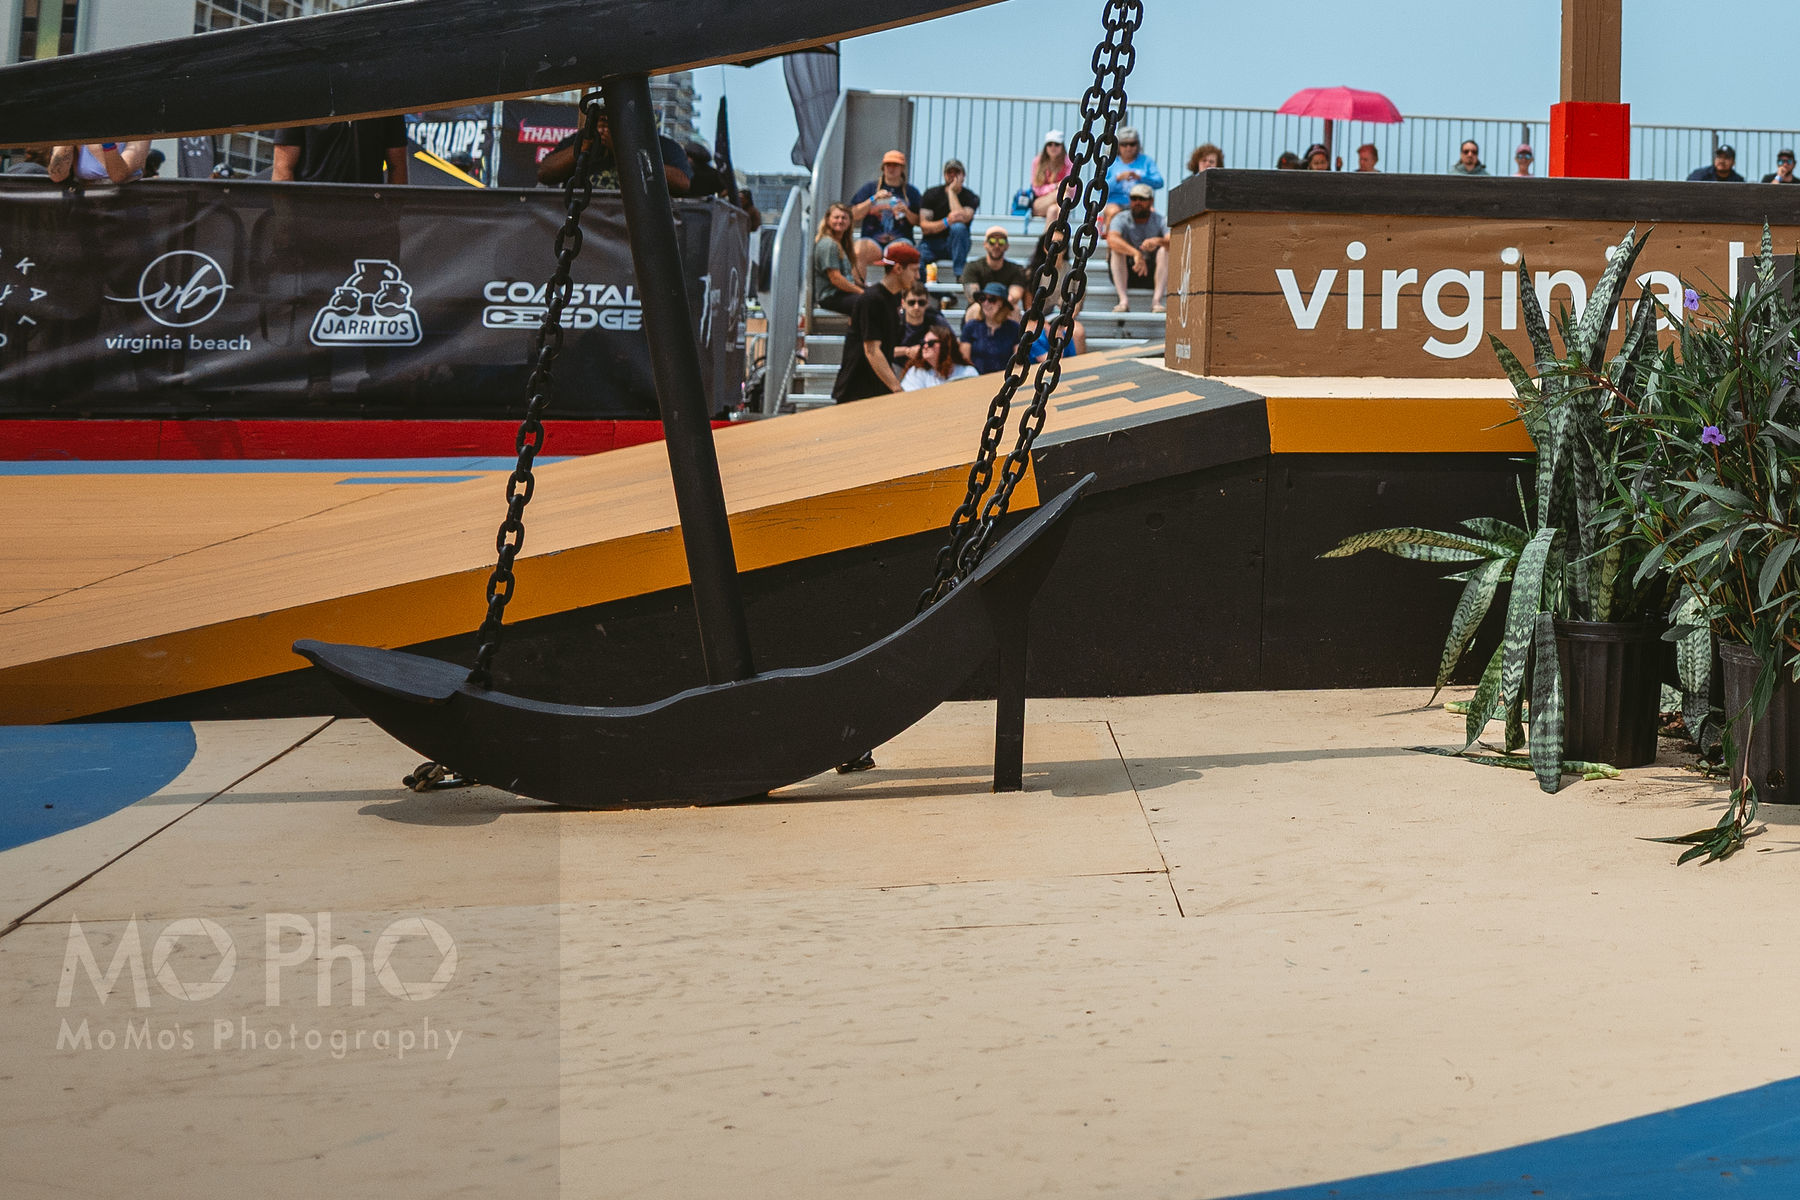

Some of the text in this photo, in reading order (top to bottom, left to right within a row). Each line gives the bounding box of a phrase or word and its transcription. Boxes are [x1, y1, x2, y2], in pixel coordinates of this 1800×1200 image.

[323, 317, 410, 337] JARRITOS
[105, 333, 251, 354] virginia beach
